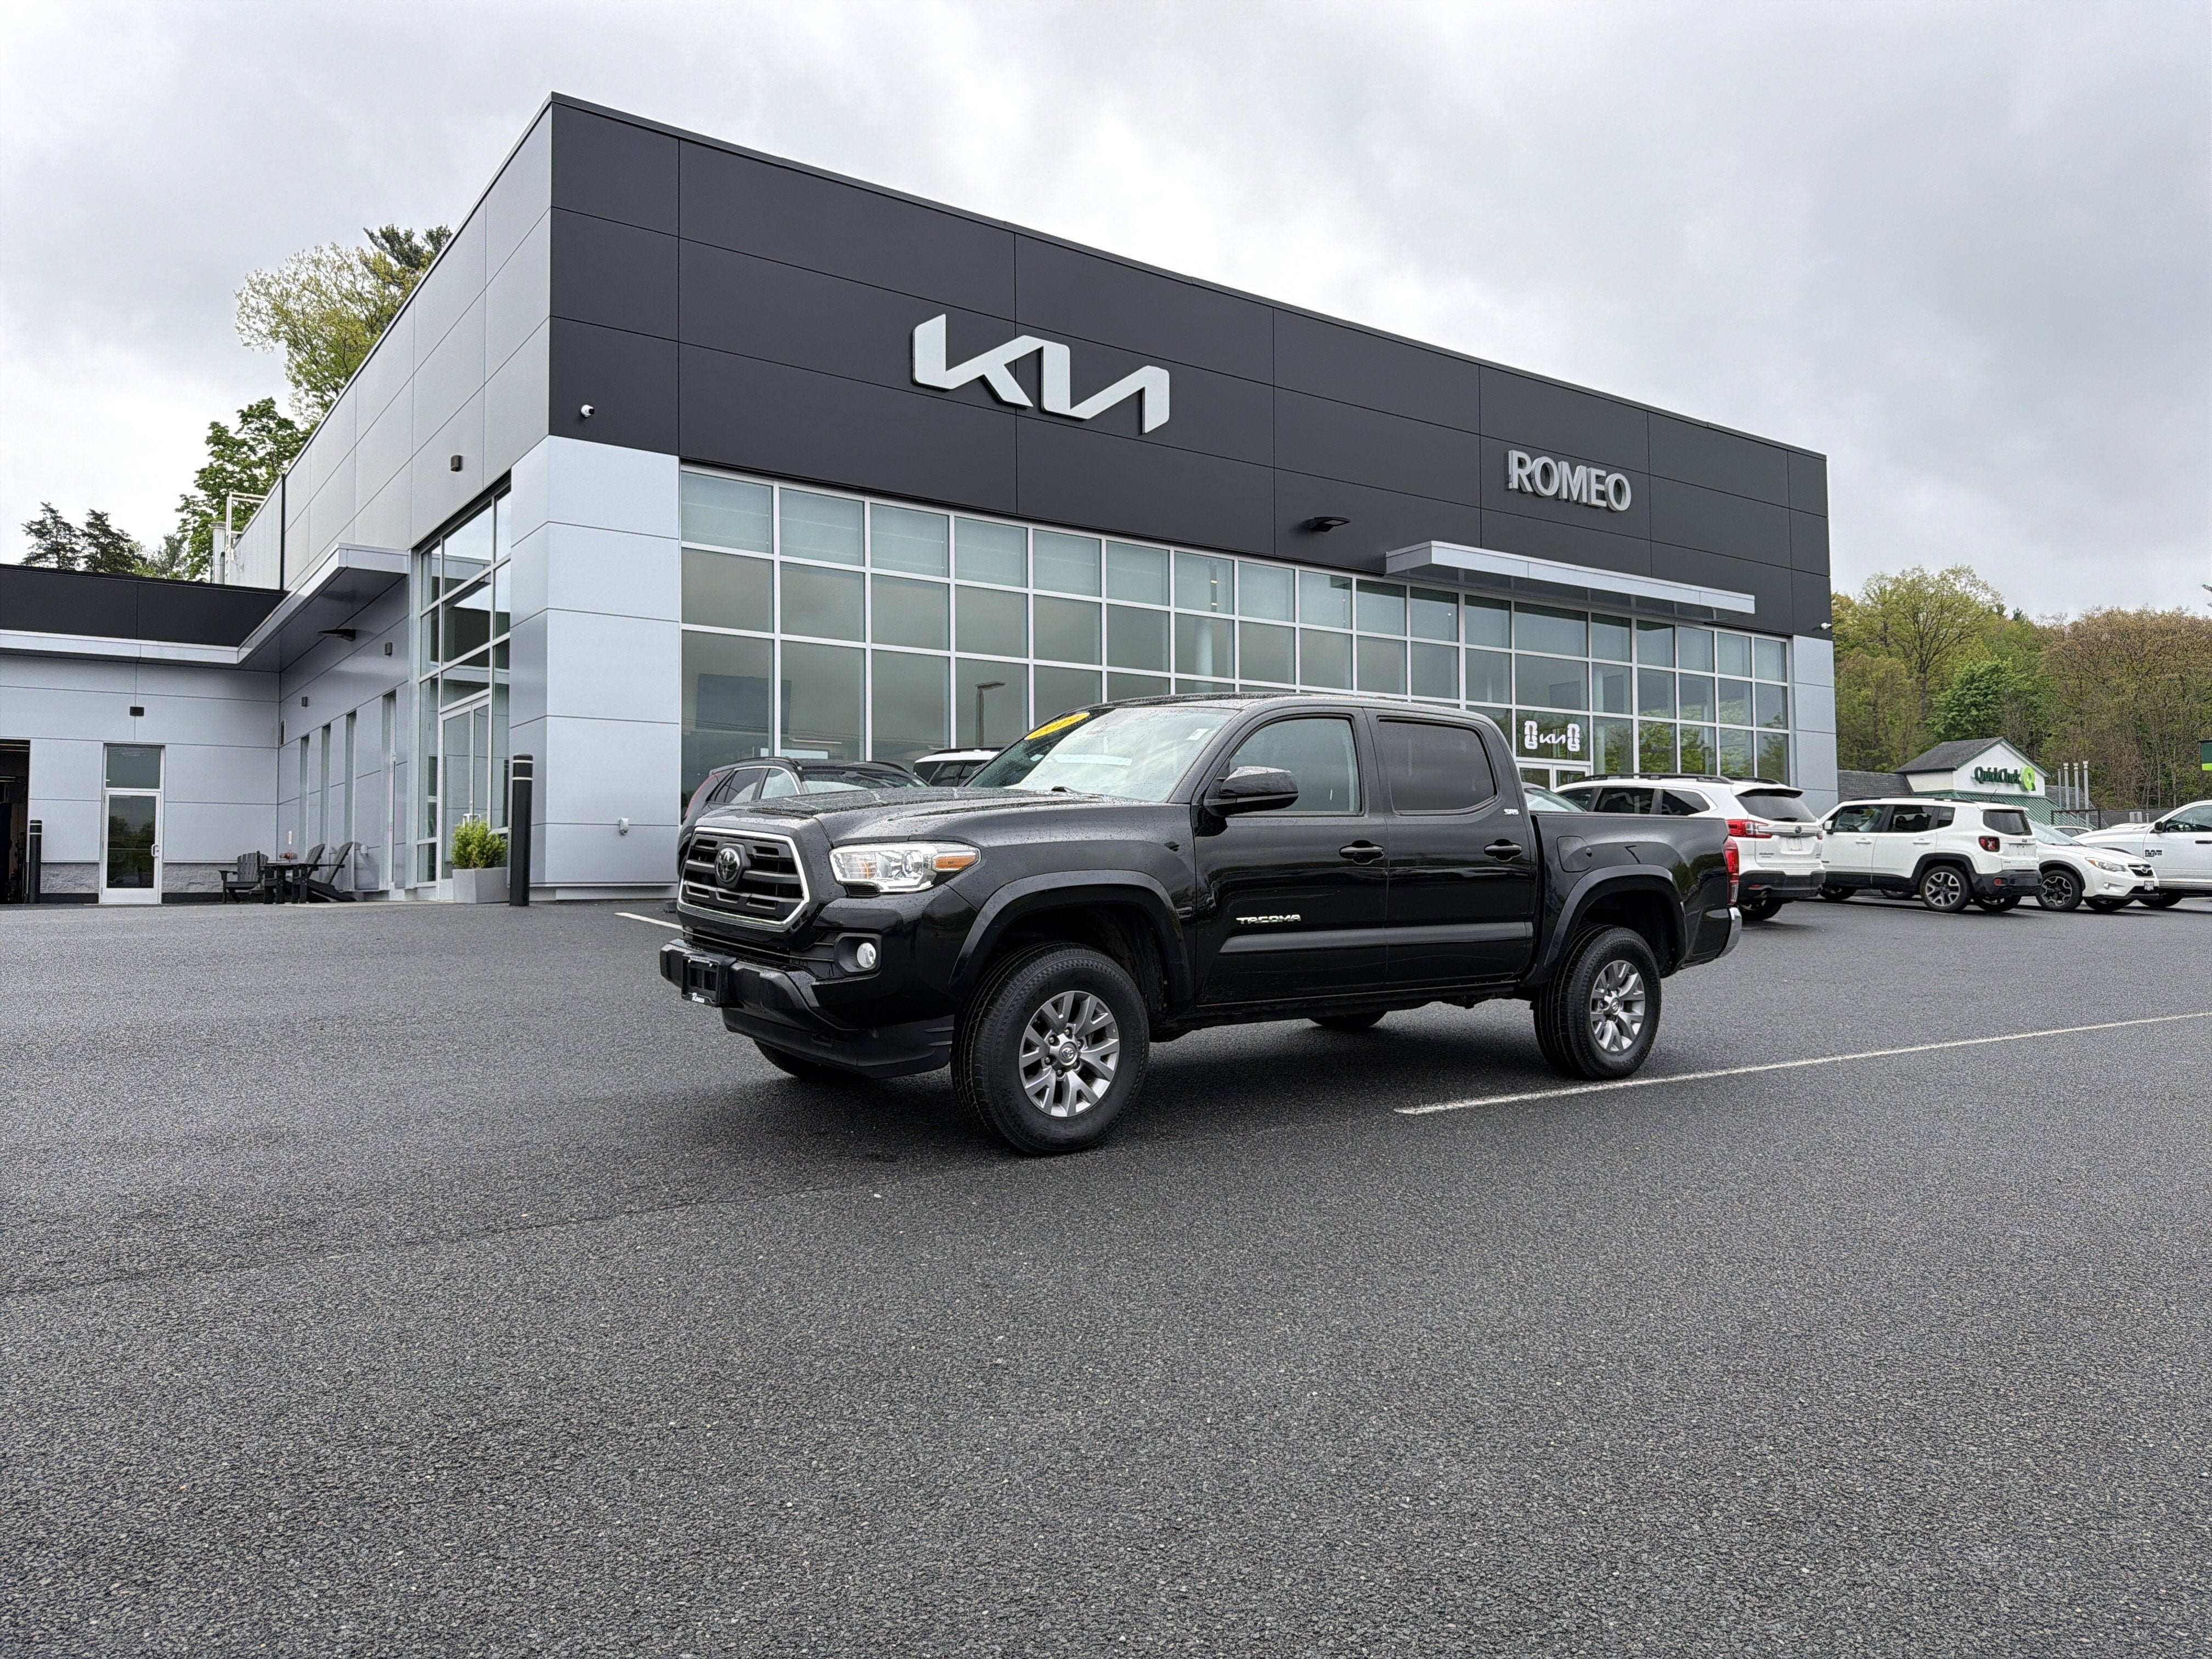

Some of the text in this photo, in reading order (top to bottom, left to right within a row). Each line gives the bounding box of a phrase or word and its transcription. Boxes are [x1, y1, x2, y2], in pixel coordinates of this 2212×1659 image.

[912, 313, 1170, 433] KIA
[1508, 449, 1632, 511] ROMEO
[1539, 733, 1566, 744] KIA
[1235, 914, 1301, 924] TACOMA
